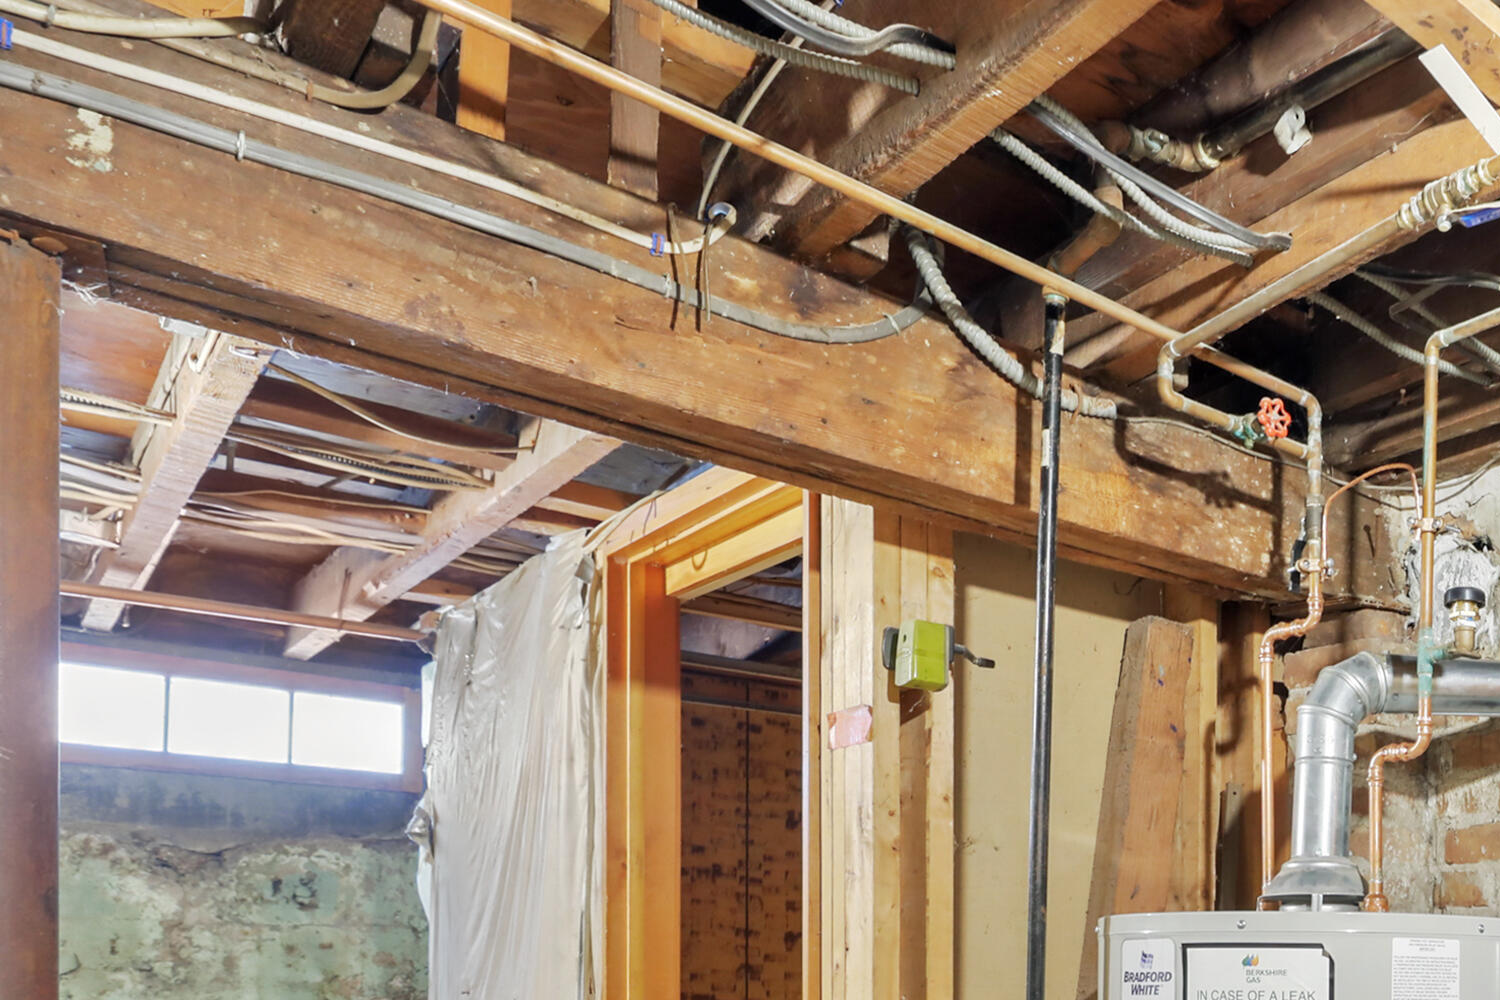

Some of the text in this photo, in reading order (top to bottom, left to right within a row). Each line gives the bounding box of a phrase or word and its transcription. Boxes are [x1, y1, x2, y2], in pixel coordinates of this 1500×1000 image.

[1124, 971, 1172, 982] BRADFORD
[1131, 984, 1160, 996] WHITE
[1196, 990, 1208, 1000] IN
[1210, 990, 1243, 1000] CASE
[1248, 990, 1265, 1000] OF
[1269, 991, 1278, 1000] A
